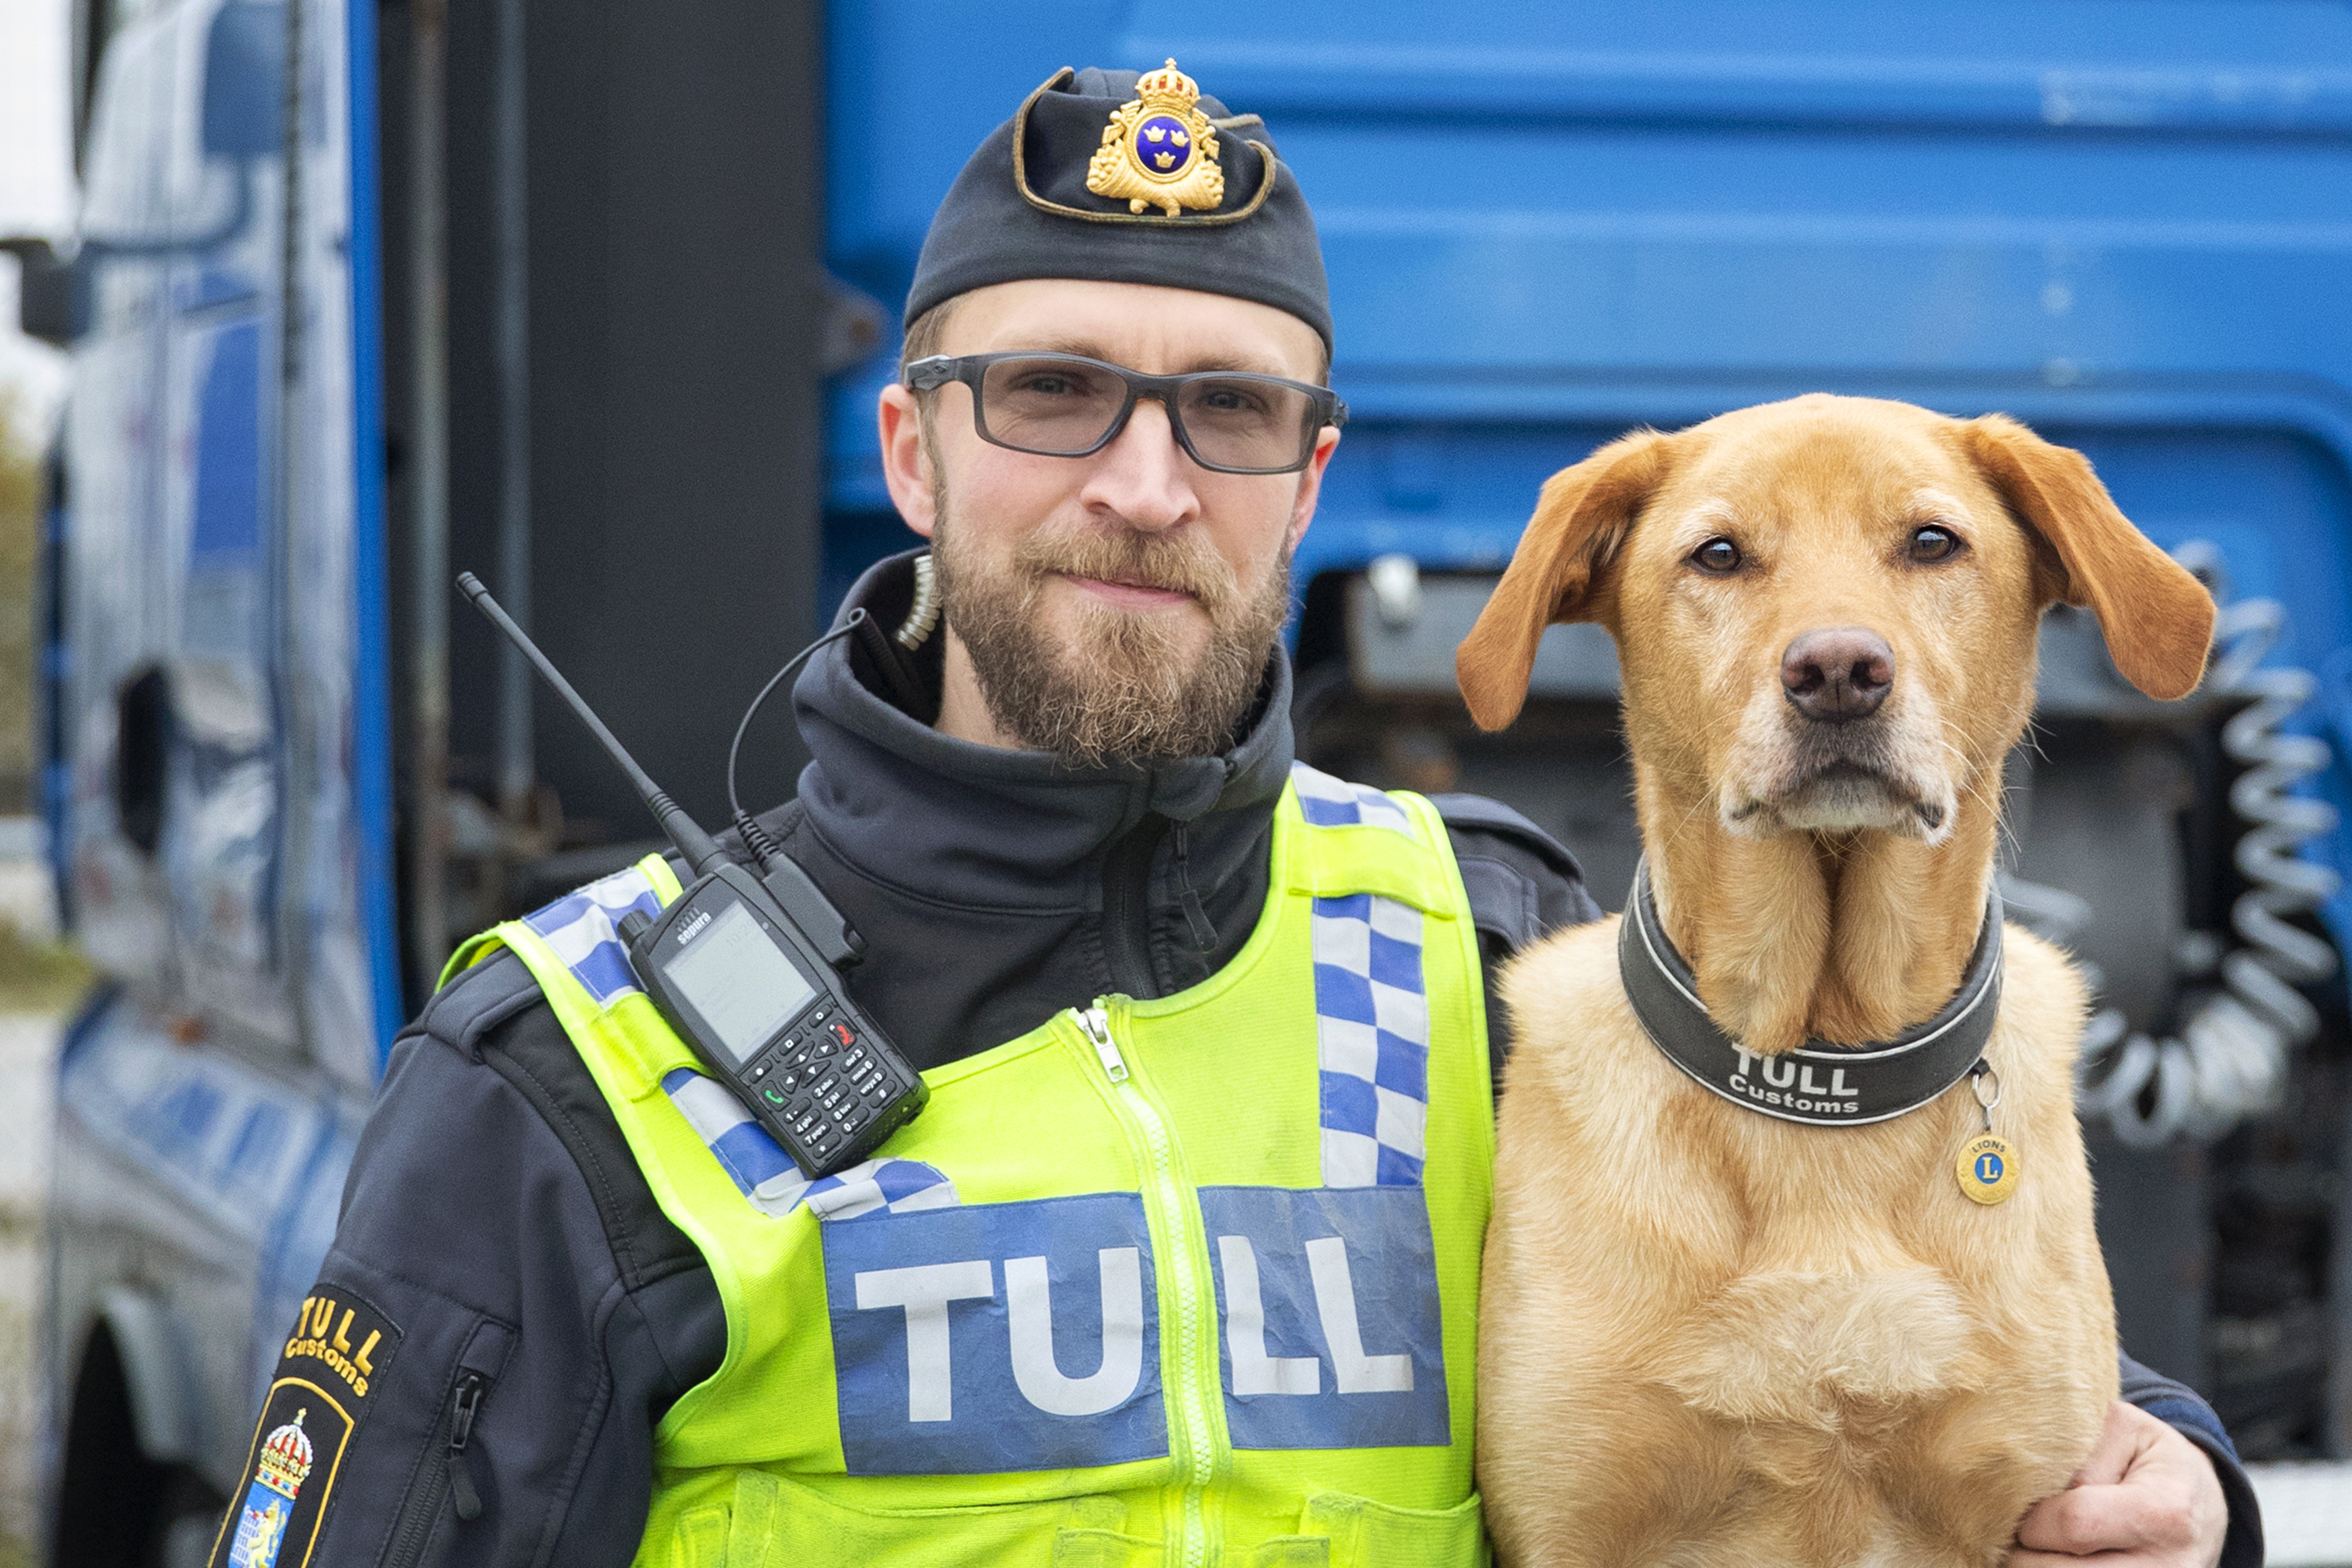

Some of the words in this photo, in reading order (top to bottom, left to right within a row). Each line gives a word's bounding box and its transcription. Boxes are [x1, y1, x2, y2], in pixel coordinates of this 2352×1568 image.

[677, 912, 711, 945] sepura
[845, 1054, 857, 1066] def
[854, 1049, 863, 1057] 3
[852, 1067, 867, 1081] mno
[864, 1060, 873, 1070] 6
[1731, 1041, 1858, 1096] TULL
[814, 1087, 823, 1097] 2
[821, 1079, 834, 1091] abc
[860, 1078, 877, 1094] wxyz
[874, 1072, 883, 1081] 9
[1729, 1074, 1858, 1113] Customs
[824, 1099, 832, 1108] 5
[834, 1111, 842, 1120] 8
[839, 1103, 851, 1114] tuv
[786, 1112, 794, 1121] 1
[843, 1122, 852, 1132] 0
[796, 1124, 804, 1132] 4
[804, 1134, 812, 1145] 7
[812, 1124, 827, 1140] pqrs
[1971, 1140, 2006, 1153] LIONS
[1982, 1157, 1998, 1178] L
[298, 1297, 382, 1377] TULL
[855, 1235, 1414, 1422] TULL
[285, 1337, 369, 1397] Customs
